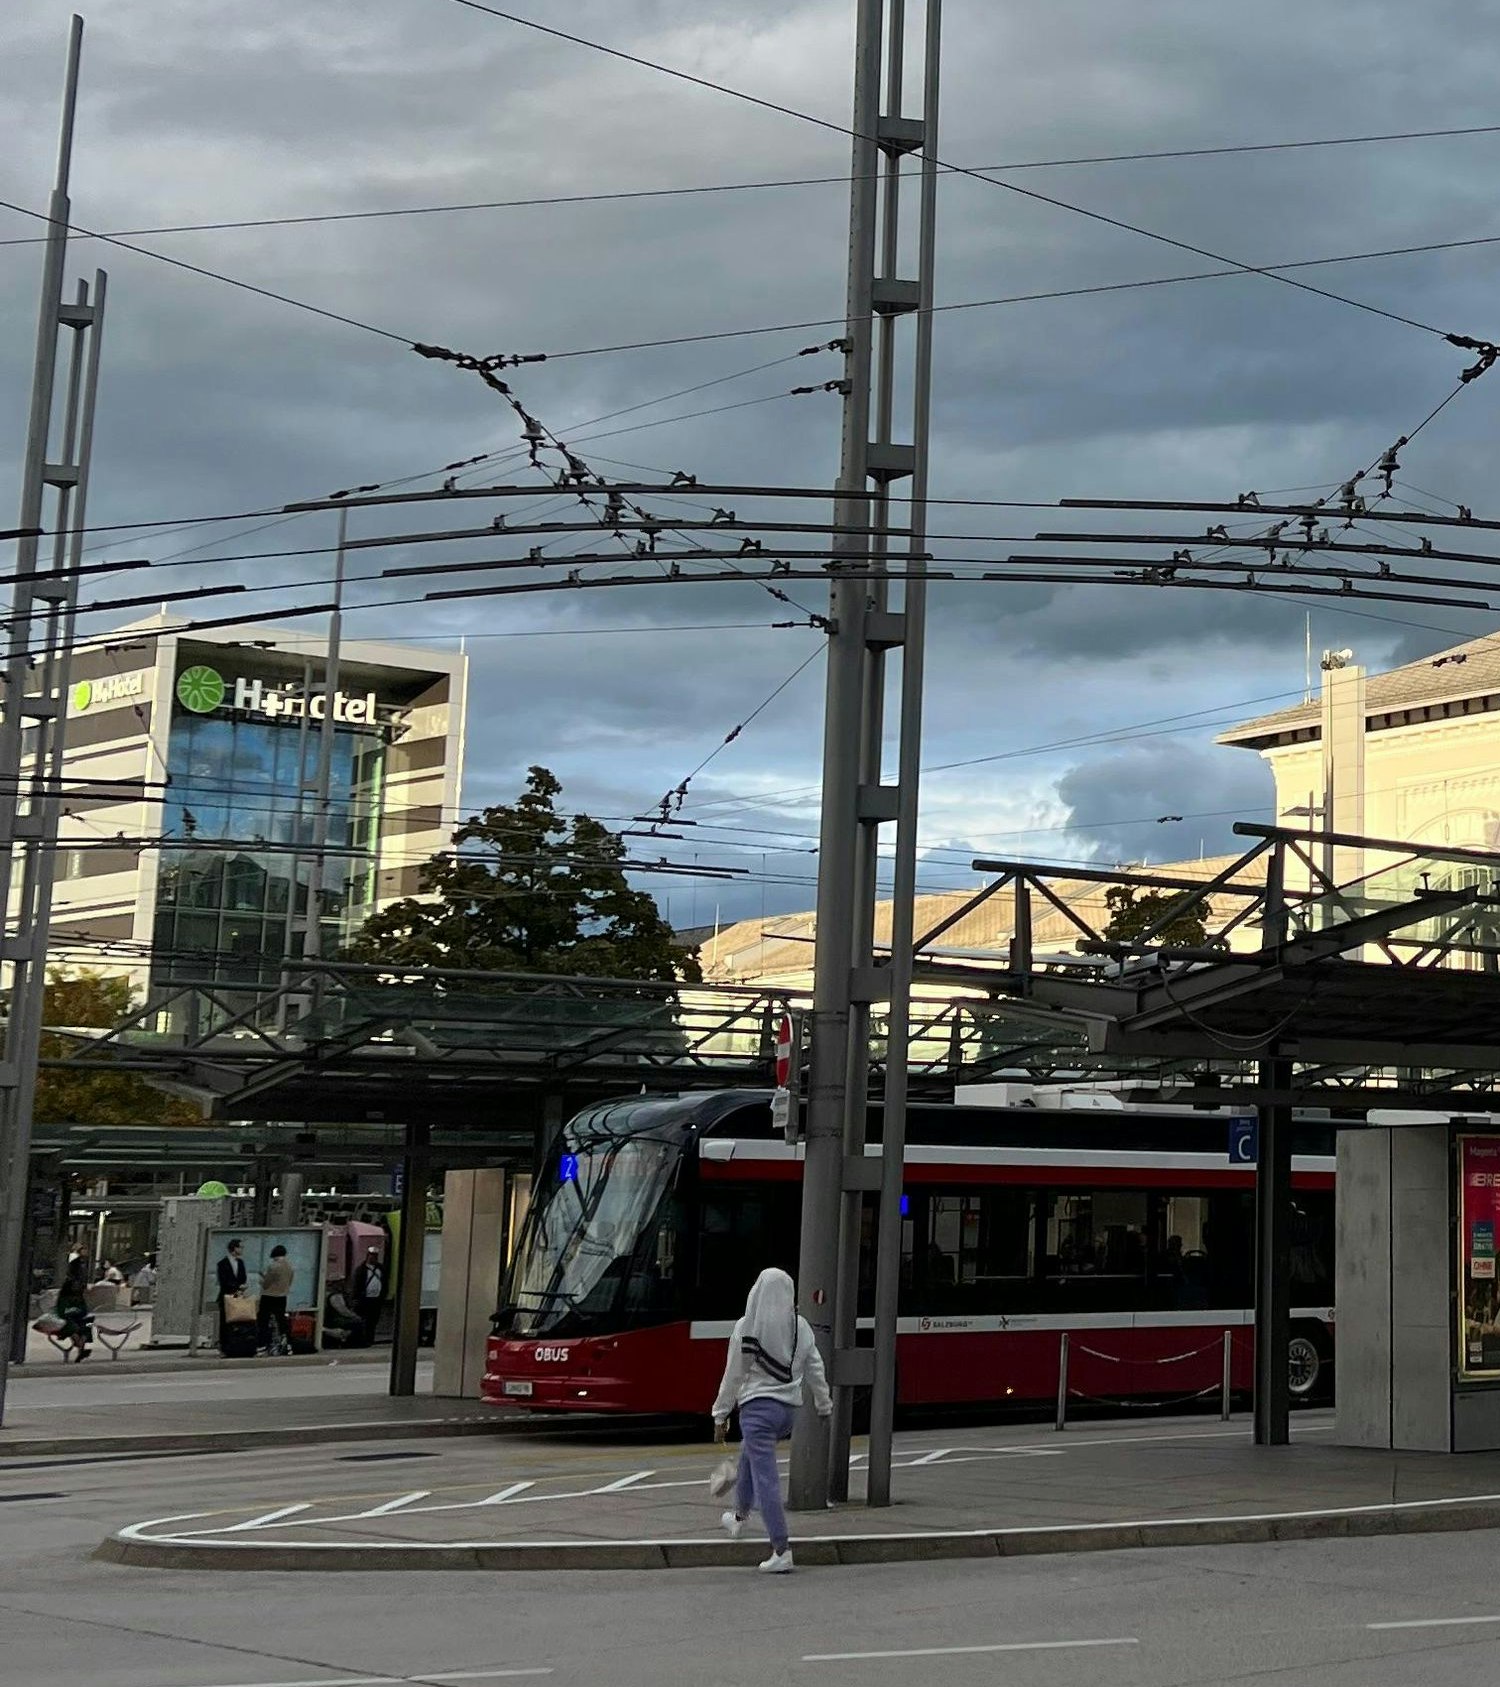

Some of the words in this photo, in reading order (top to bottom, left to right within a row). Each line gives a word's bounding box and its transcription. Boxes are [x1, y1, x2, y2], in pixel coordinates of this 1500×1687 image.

[1238, 1134, 1251, 1160] C
[564, 1156, 574, 1178] 2
[534, 1346, 570, 1362] OBUS
